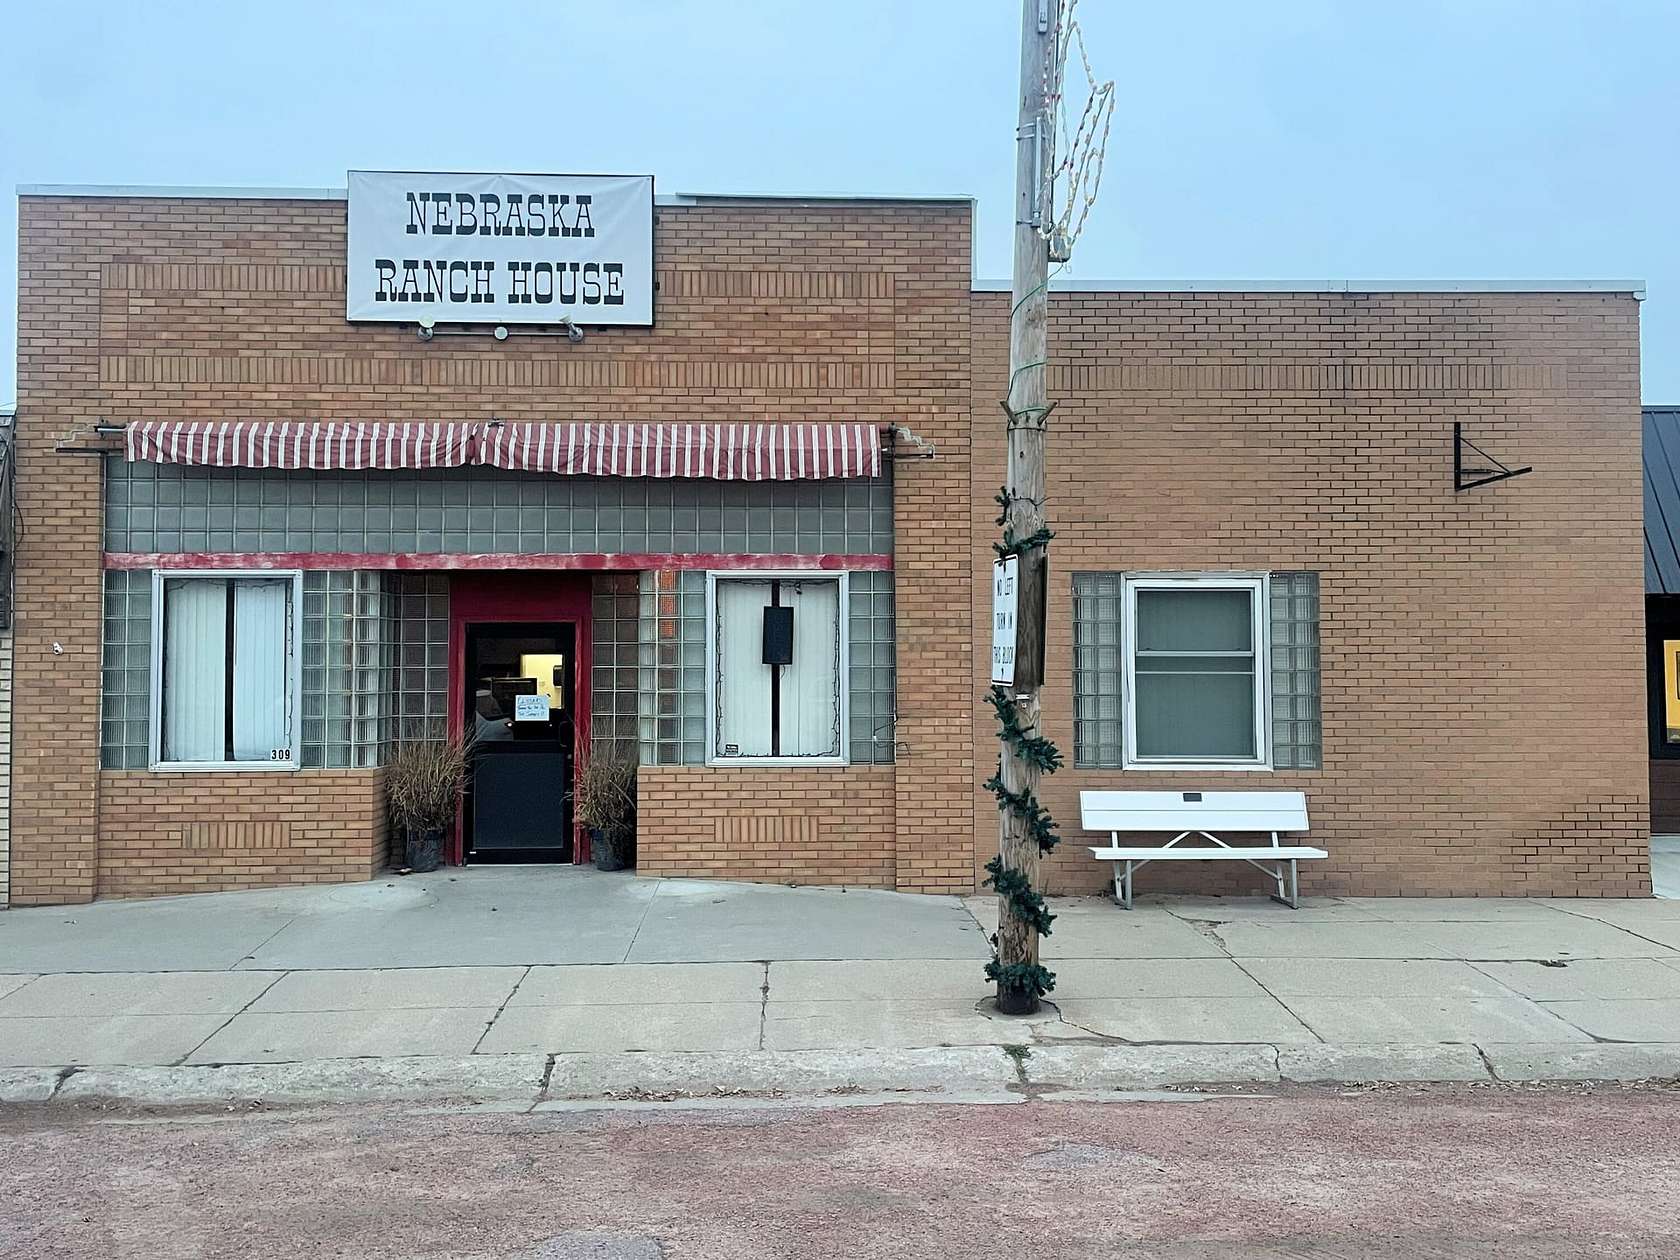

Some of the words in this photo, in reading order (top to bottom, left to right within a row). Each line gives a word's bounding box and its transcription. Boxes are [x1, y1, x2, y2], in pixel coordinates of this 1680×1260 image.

[406, 192, 595, 237] NEBRASKA
[375, 259, 495, 304] RANCH
[507, 261, 624, 305] HOUSE
[997, 579, 1003, 597] NO
[1004, 577, 1014, 596] LEFT
[996, 612, 1006, 630] TURN
[993, 646, 1001, 664] THIS
[1002, 646, 1014, 665] BLOCK
[271, 749, 291, 760] 309
